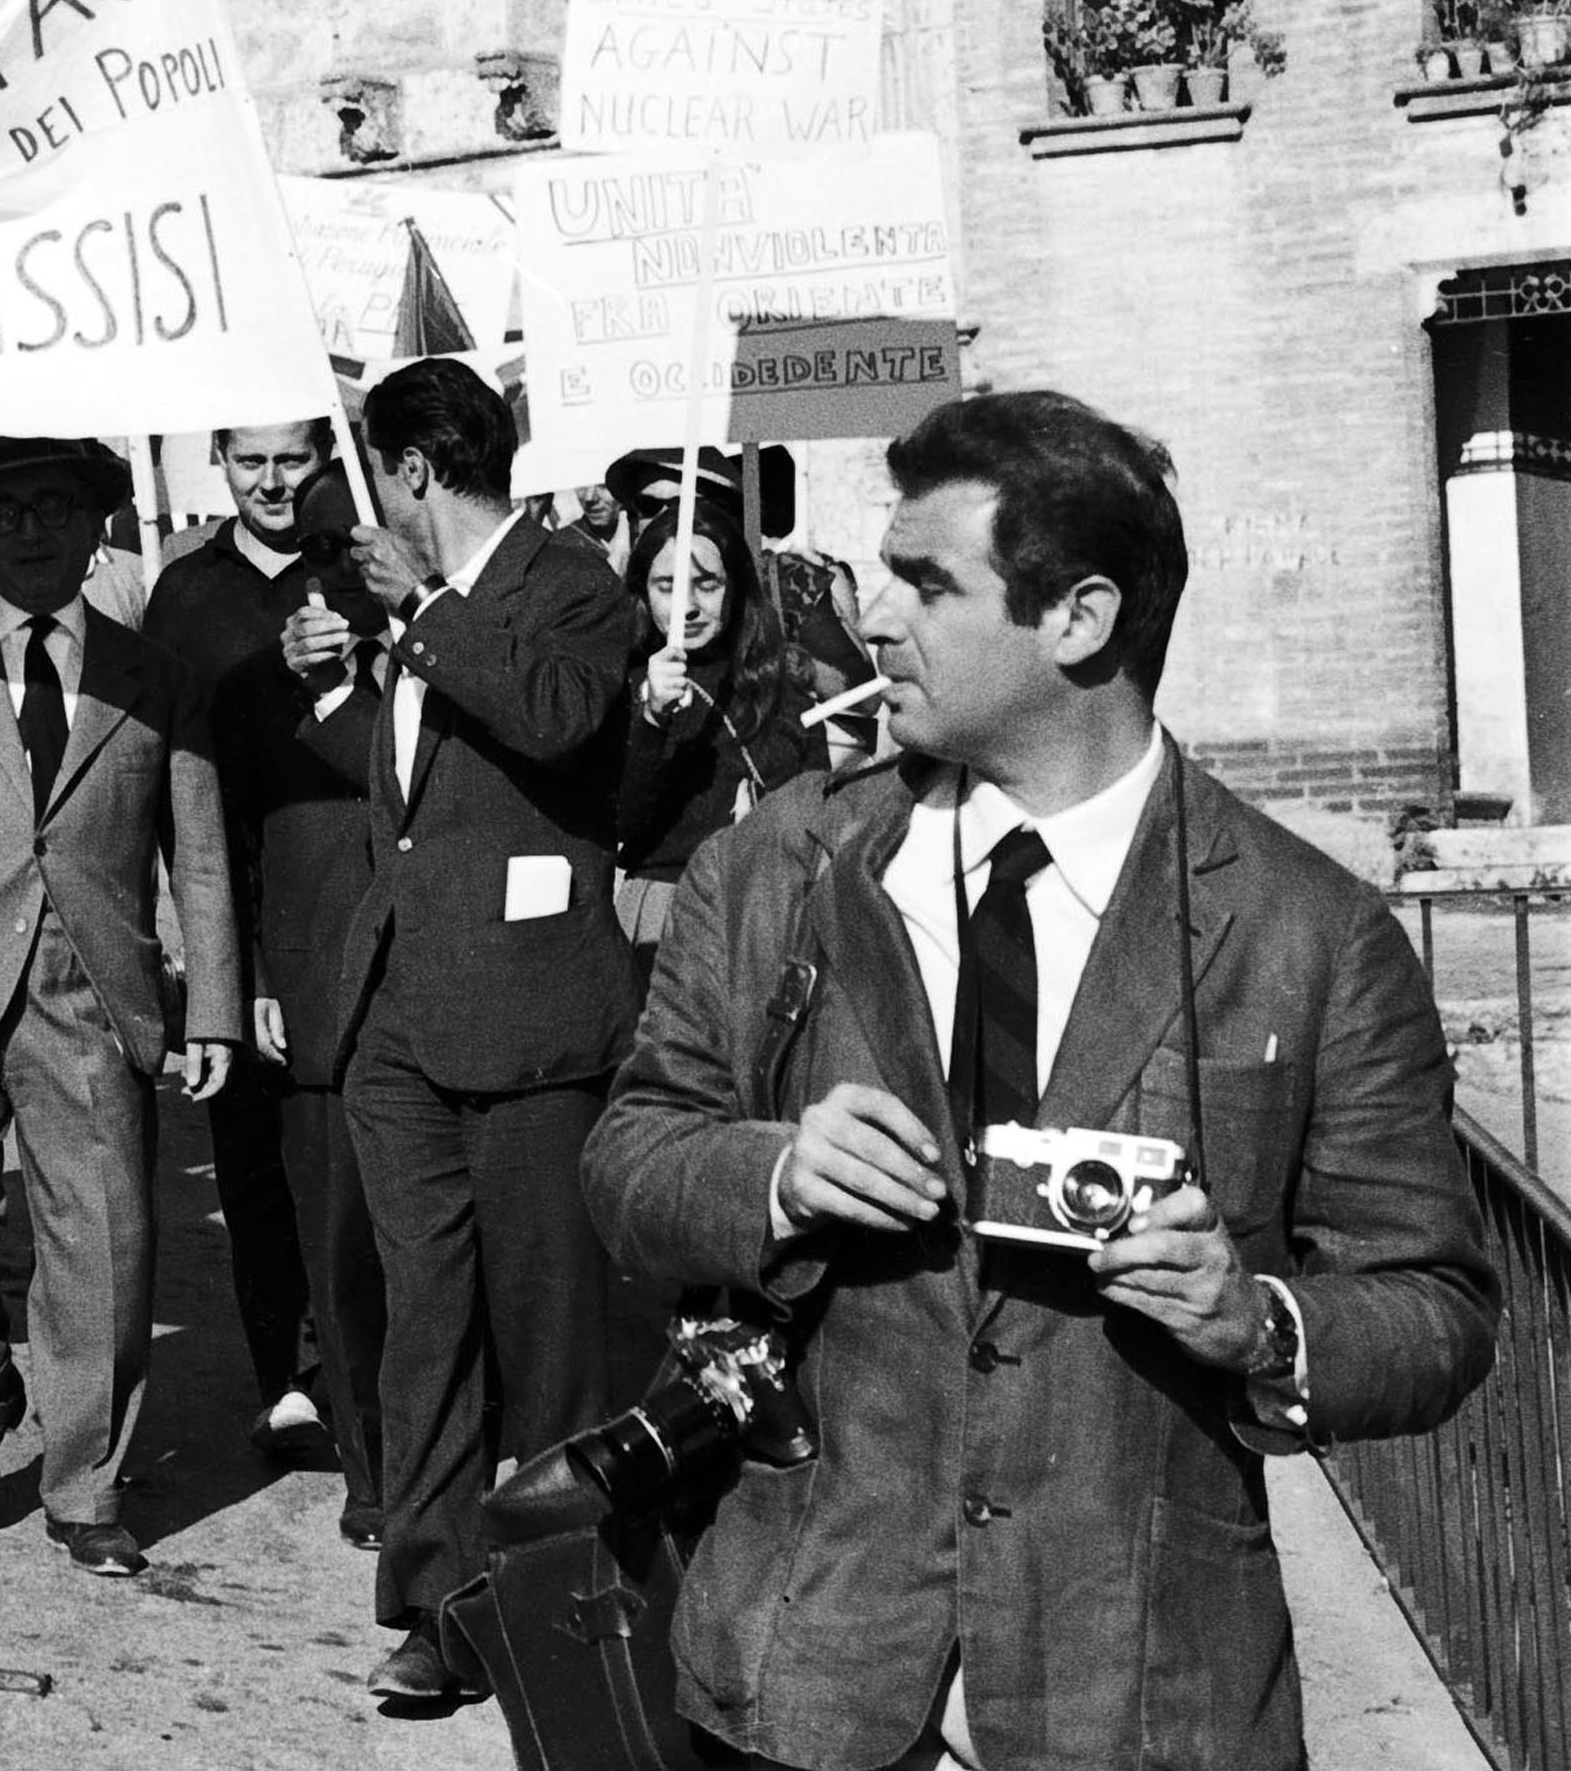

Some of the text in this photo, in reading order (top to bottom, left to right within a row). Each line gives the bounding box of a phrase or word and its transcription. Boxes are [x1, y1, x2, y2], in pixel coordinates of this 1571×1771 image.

[590, 20, 848, 83] AGAINST
[8, 96, 85, 164] DEI
[579, 91, 871, 143] NUCLEAR WAR
[569, 289, 671, 340] FRA
[559, 365, 591, 398] E
